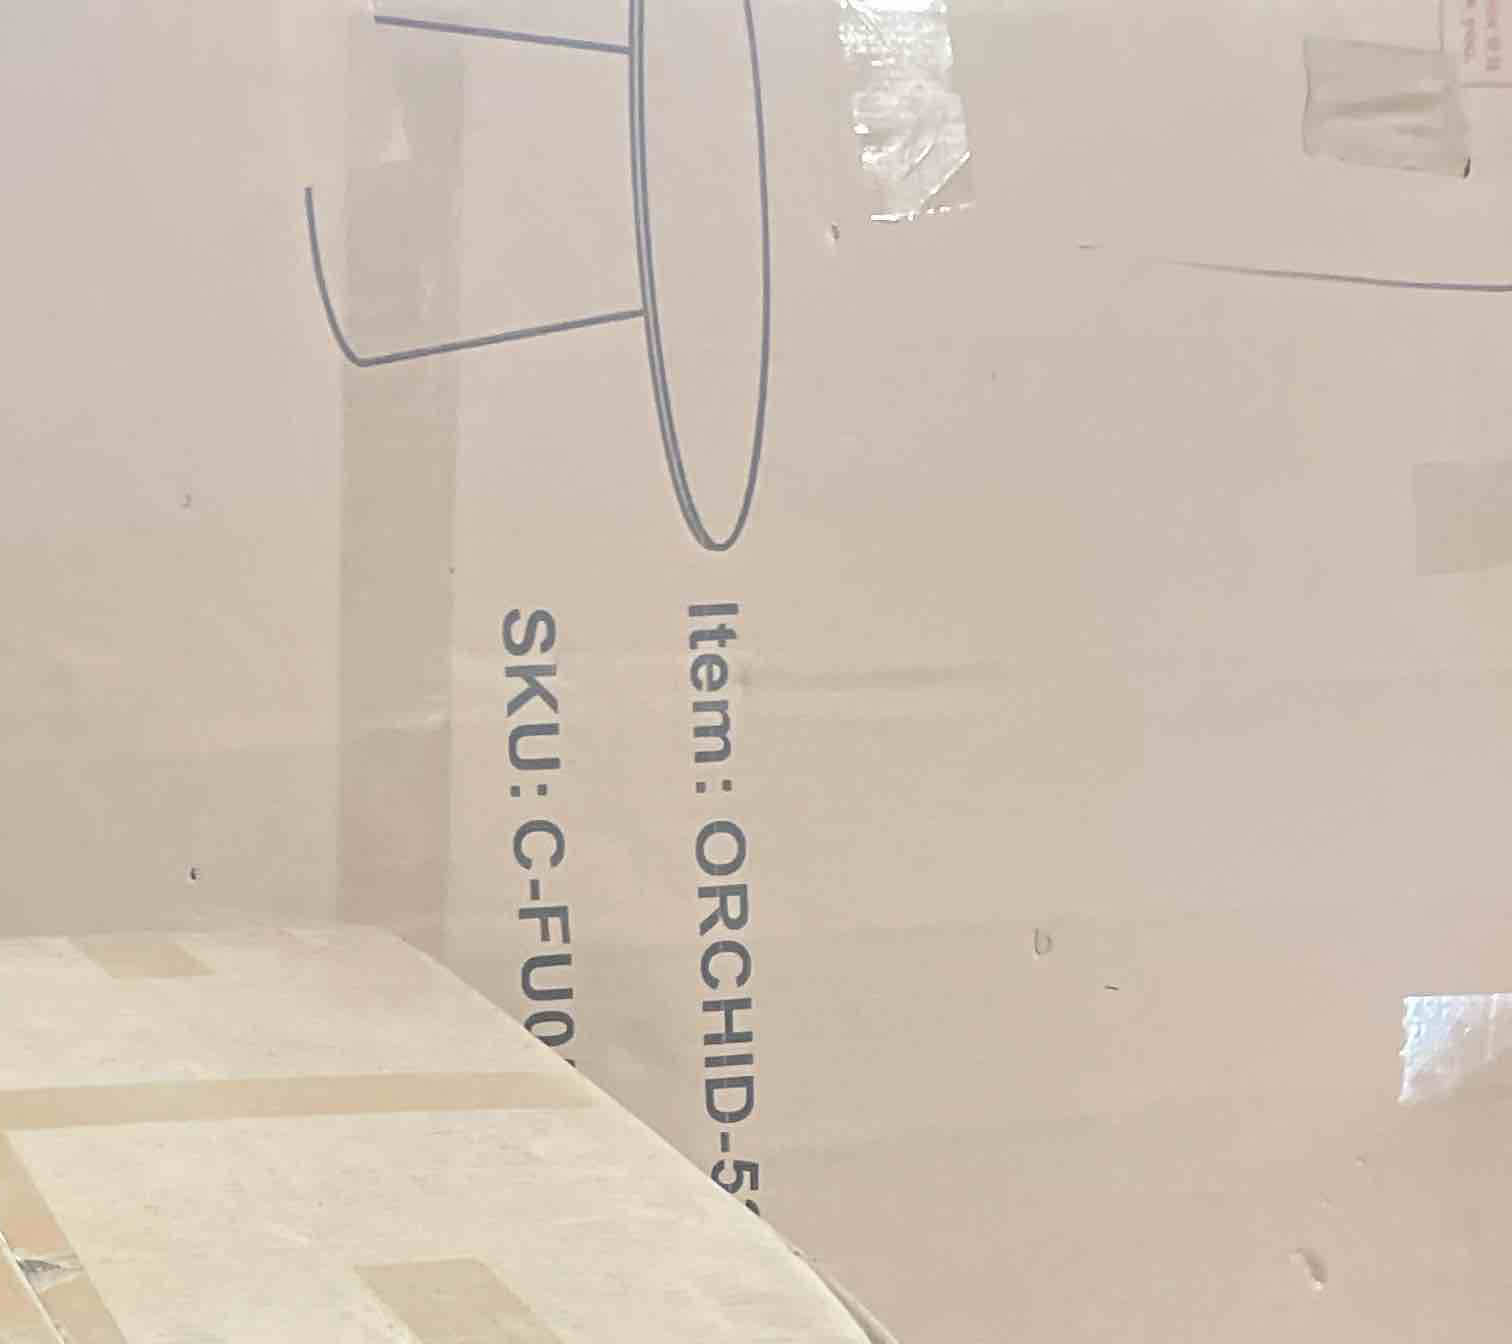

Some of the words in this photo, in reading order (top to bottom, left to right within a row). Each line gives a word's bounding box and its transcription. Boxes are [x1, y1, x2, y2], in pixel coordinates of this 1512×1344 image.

[501, 607, 562, 798] SKU:
[511, 818, 577, 1069] C-FU0
[694, 820, 761, 1217] ORCHID-5
